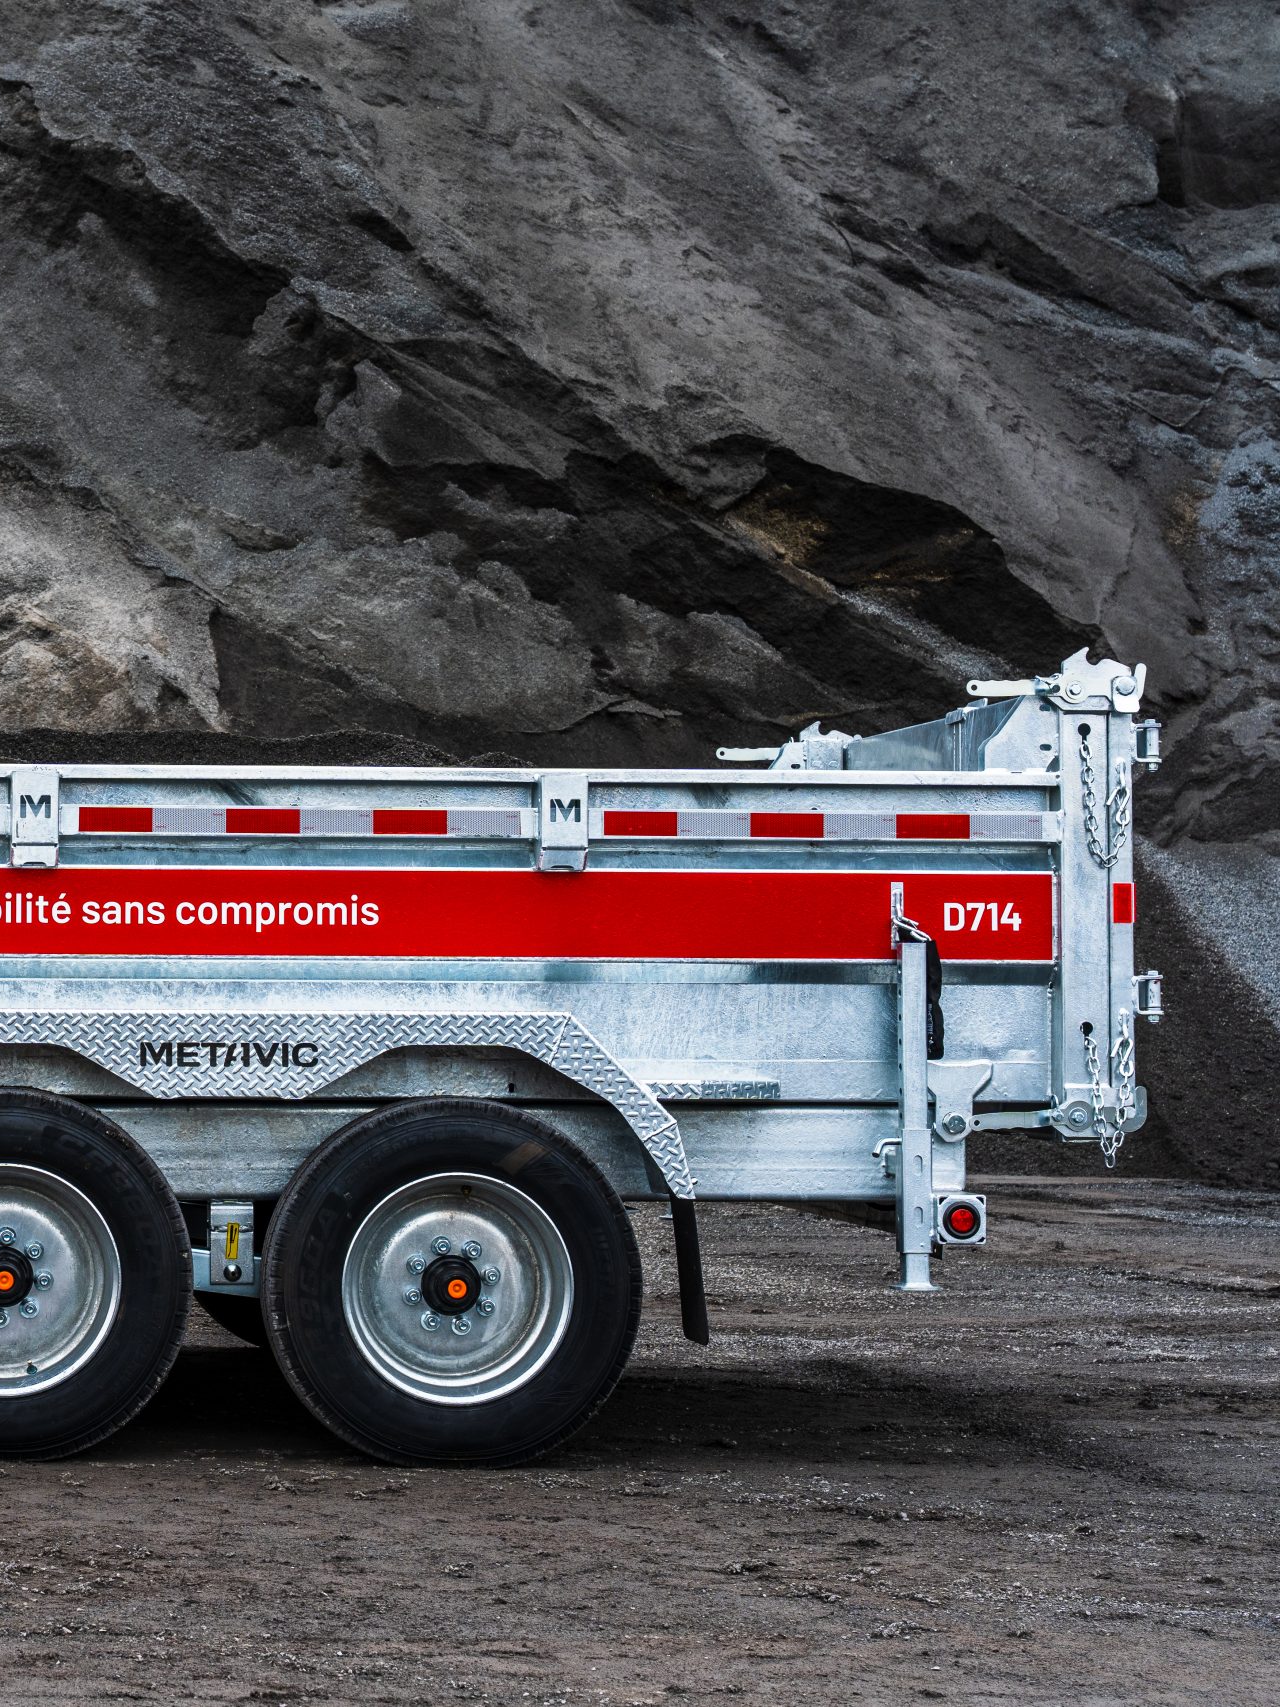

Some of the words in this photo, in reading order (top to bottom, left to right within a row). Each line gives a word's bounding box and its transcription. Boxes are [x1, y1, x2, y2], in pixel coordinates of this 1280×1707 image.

[20, 794, 52, 819] M
[550, 798, 581, 823] M
[81, 901, 166, 925] sans
[175, 894, 380, 933] compromis
[943, 902, 1022, 932] D714
[139, 1041, 319, 1068] METAVIC
